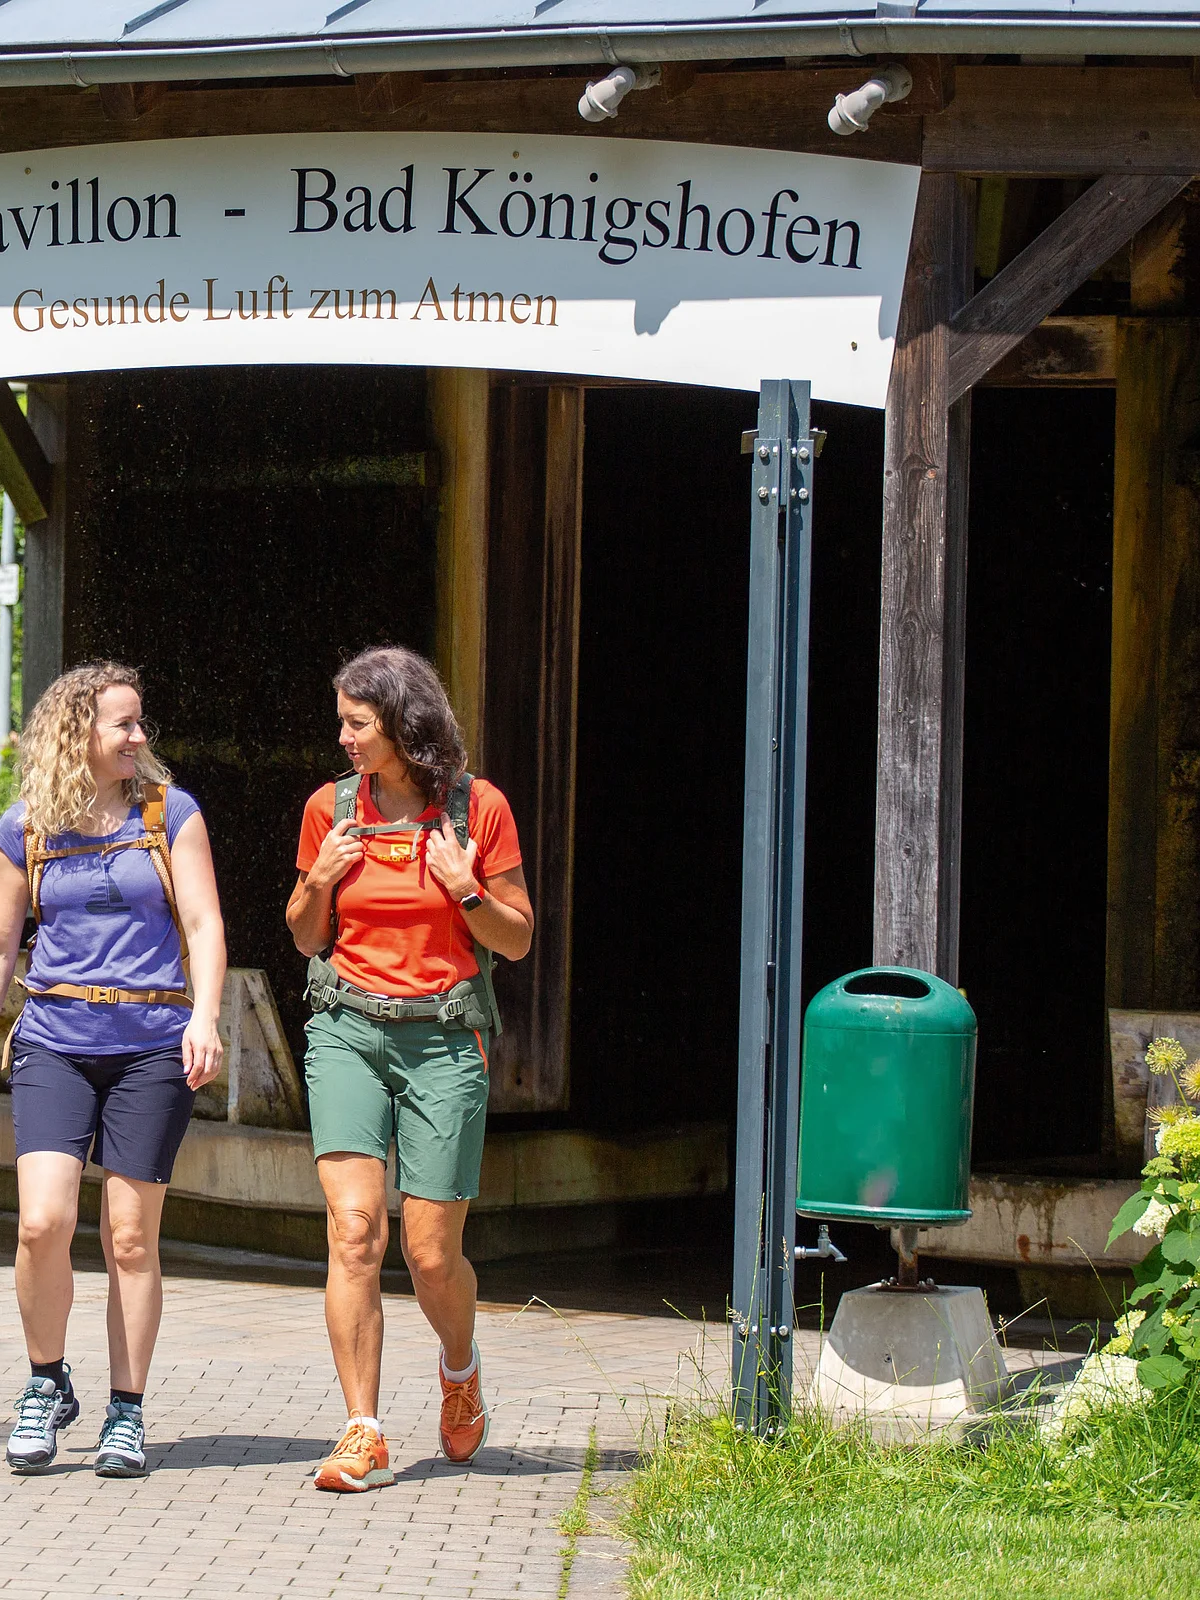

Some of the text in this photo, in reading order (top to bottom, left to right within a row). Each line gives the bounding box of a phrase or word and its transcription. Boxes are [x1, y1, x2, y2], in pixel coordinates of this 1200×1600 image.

[224, 208, 246, 218] -
[288, 163, 417, 234] Bad
[437, 167, 863, 270] Königshofen
[12, 274, 558, 333] Gesunde Luft zum Atmen
